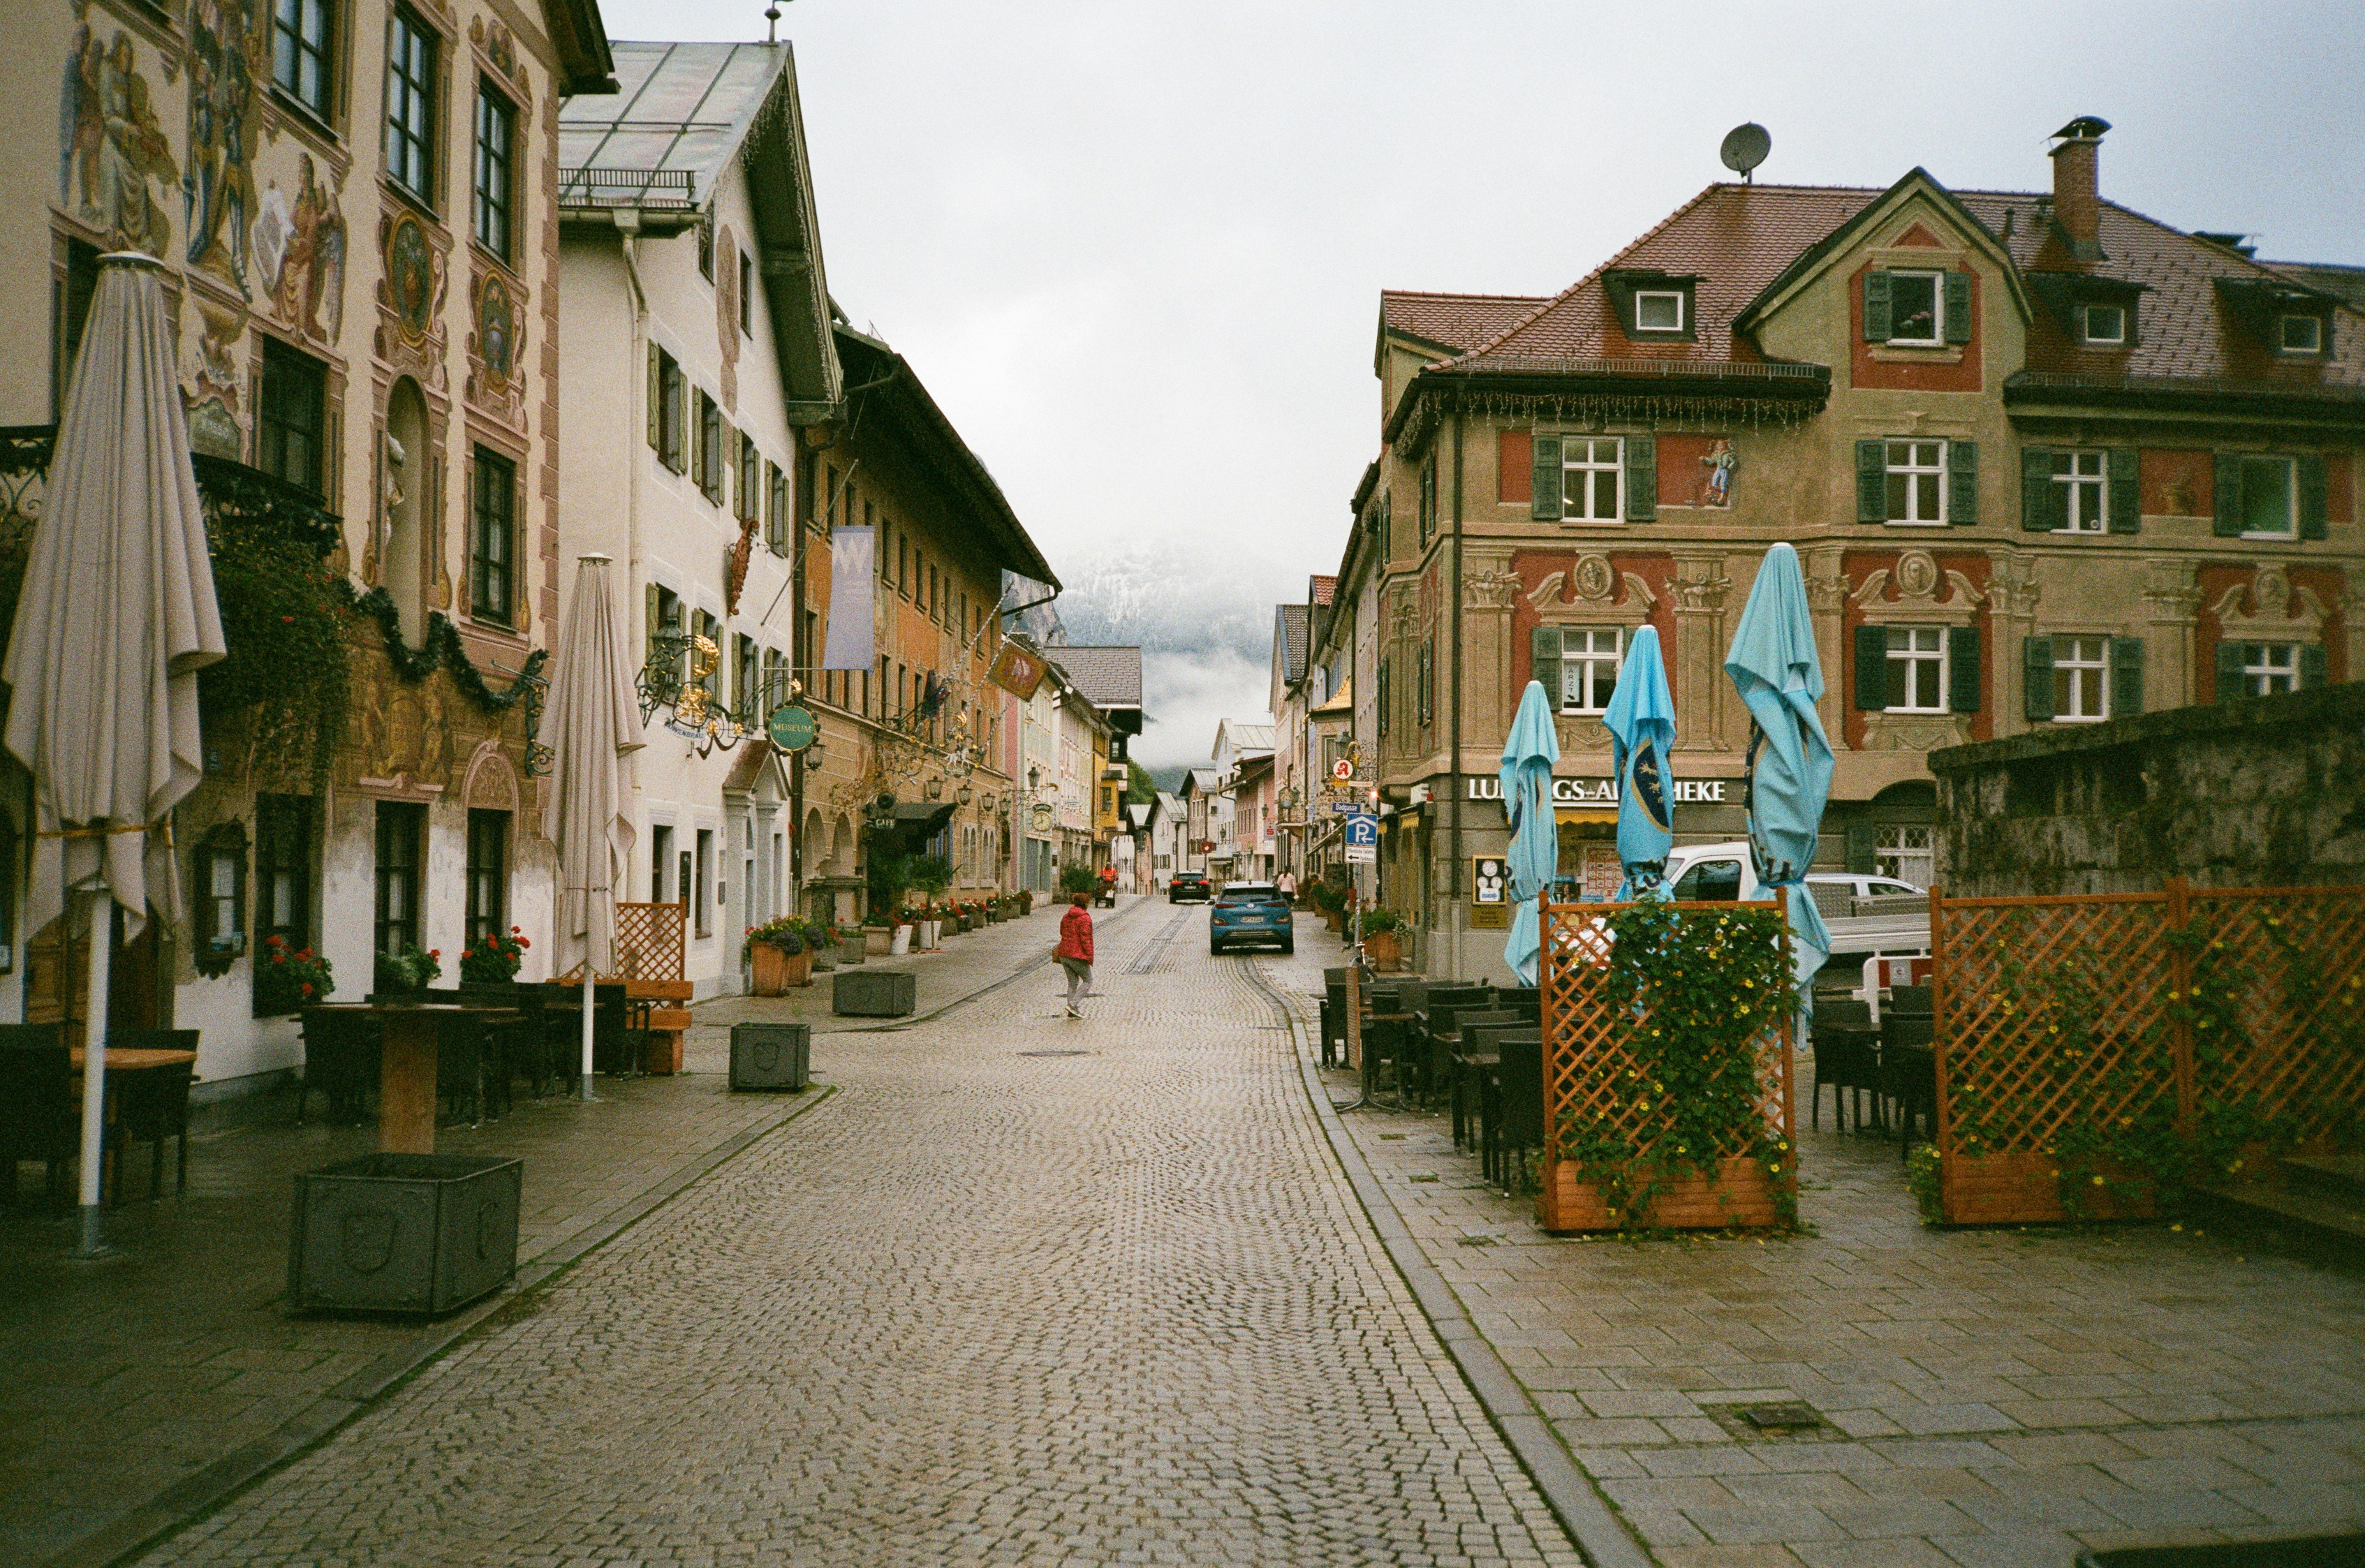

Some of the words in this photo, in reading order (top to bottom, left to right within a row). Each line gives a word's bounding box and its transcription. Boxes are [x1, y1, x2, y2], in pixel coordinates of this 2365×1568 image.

[773, 723, 811, 732] MUSEUM
[1335, 804, 1357, 813] Badgasse
[1355, 823, 1369, 843] P
